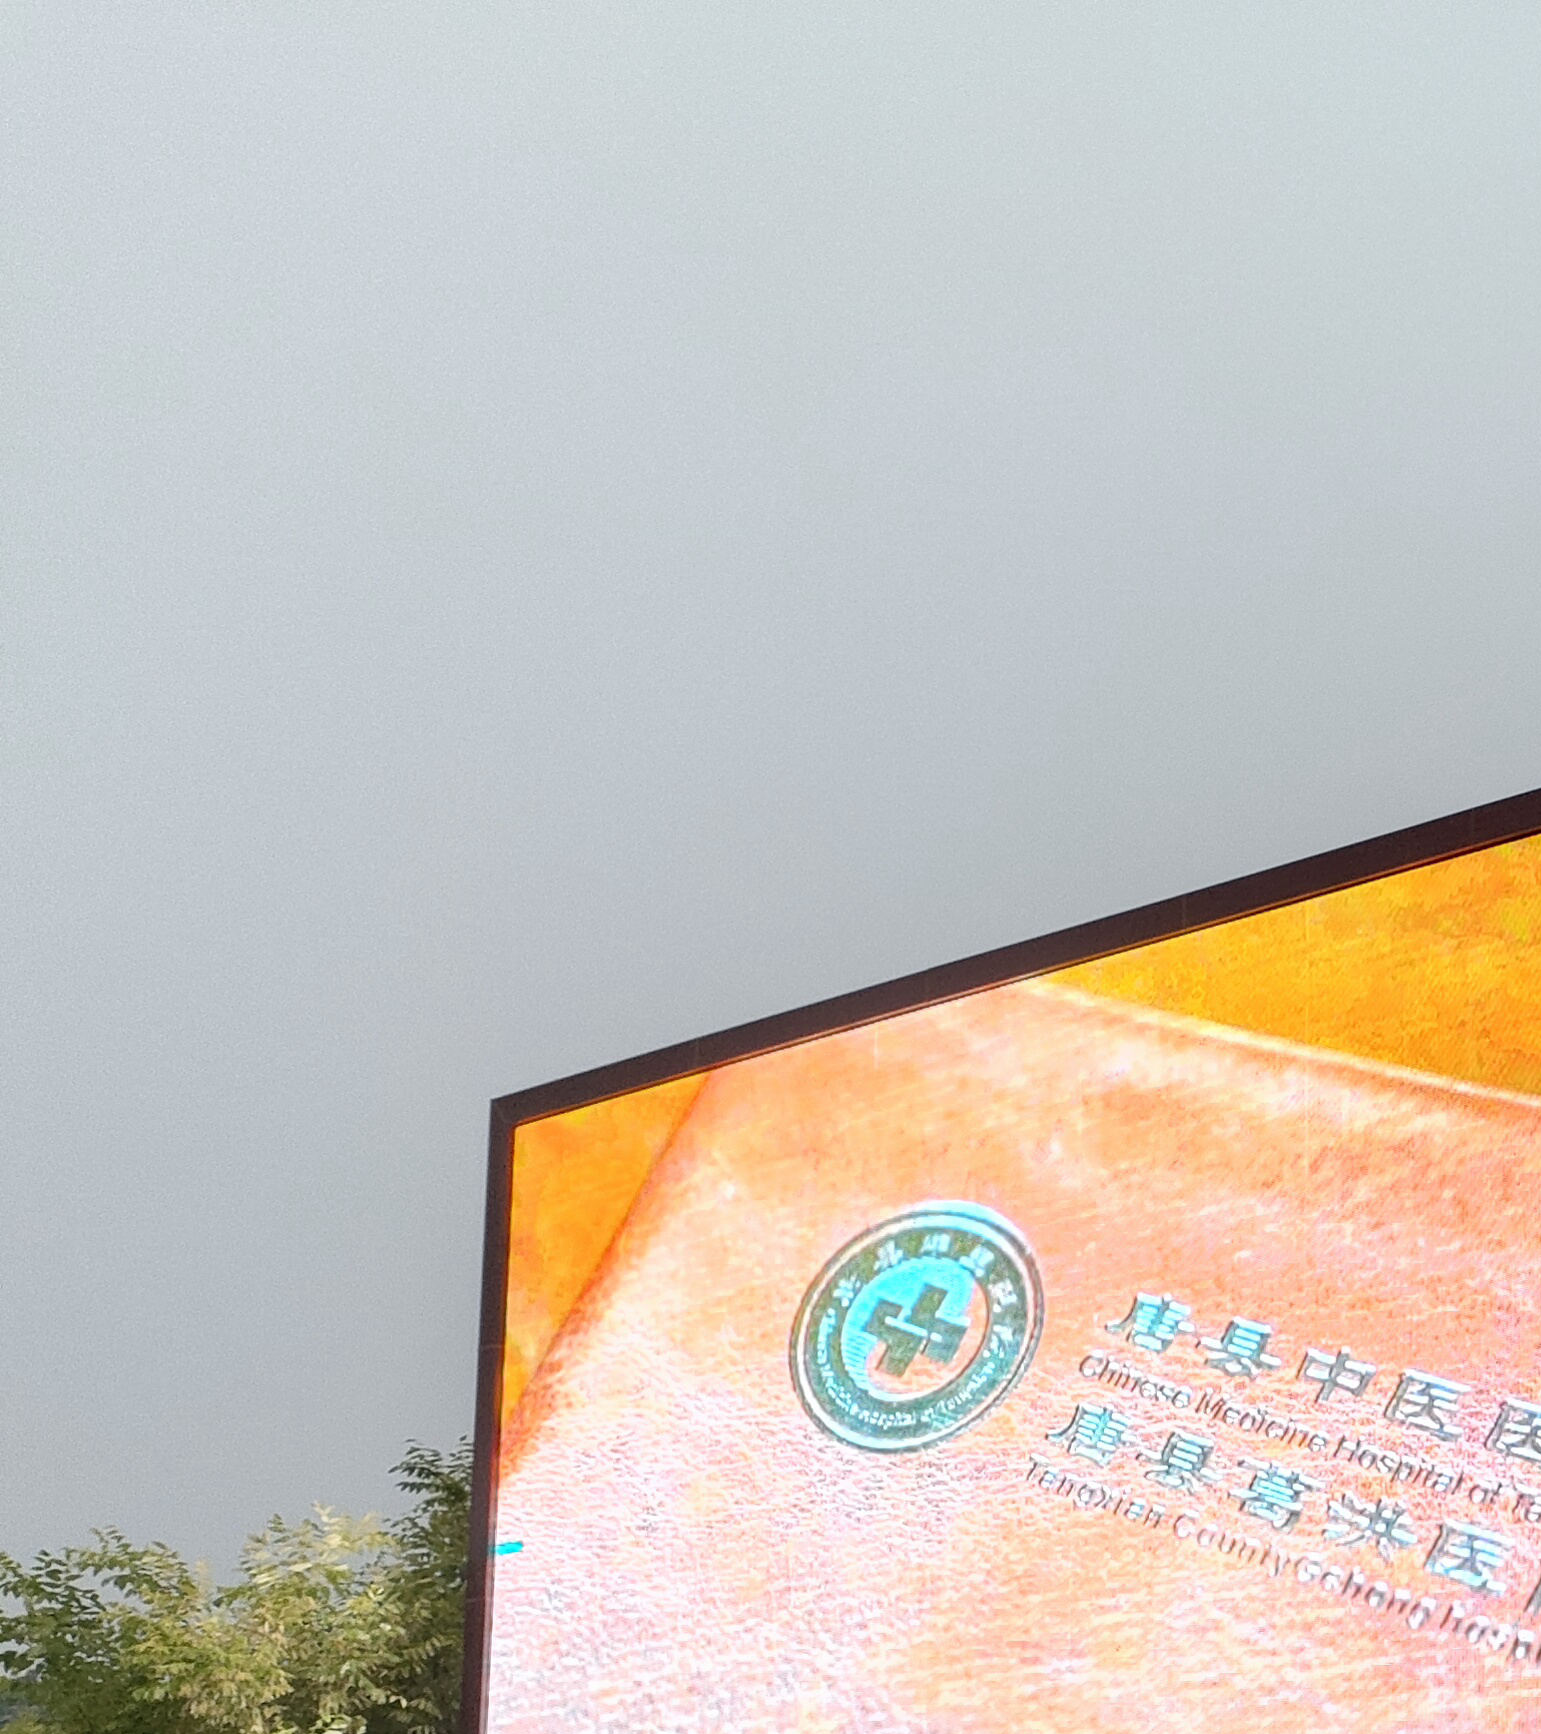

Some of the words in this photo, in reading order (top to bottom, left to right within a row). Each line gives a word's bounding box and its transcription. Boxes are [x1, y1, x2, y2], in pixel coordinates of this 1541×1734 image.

[1079, 1350, 1191, 1408] Chinese
[1195, 1388, 1327, 1452] Medicine
[1333, 1434, 1464, 1496] Hospital
